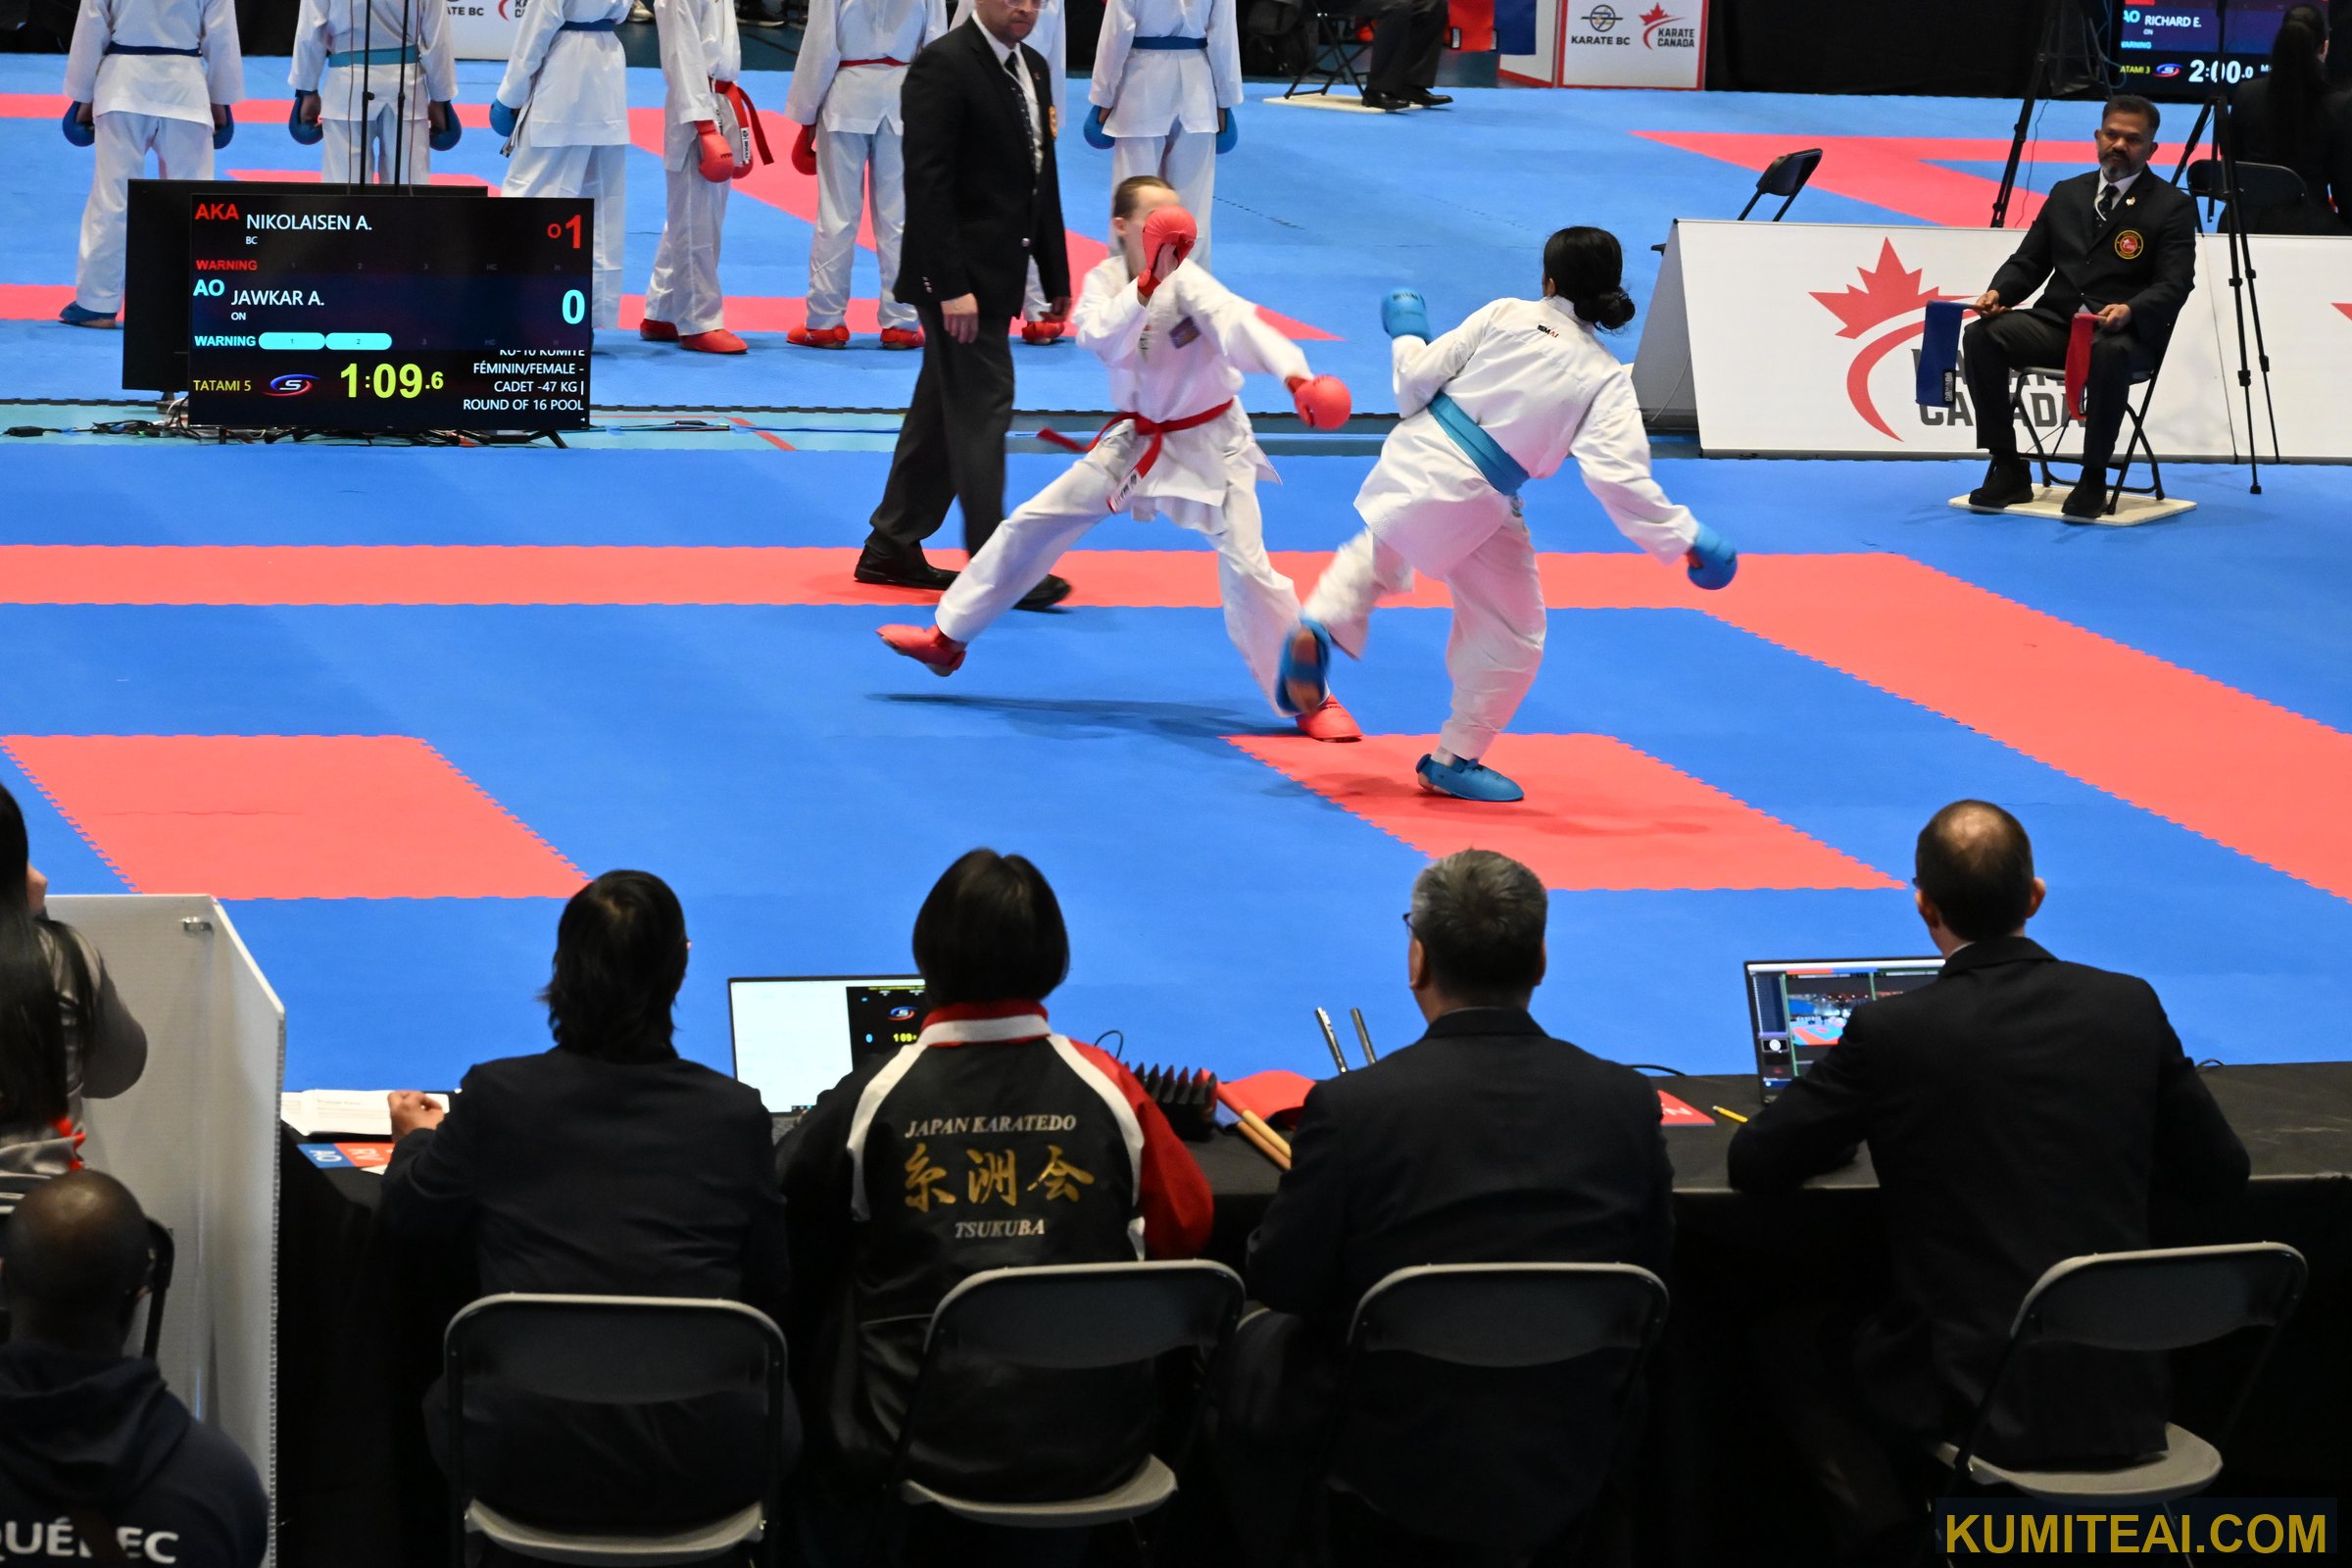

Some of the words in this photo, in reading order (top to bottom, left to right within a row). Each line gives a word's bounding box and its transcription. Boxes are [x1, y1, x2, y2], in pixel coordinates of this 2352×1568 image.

[468, 7, 484, 16] BC
[2144, 15, 2191, 27] RICHARD
[2192, 17, 2202, 27] E.
[1657, 27, 1695, 38] KARATE
[1571, 35, 1613, 45] KARATE
[1615, 36, 1631, 45] BC
[1657, 38, 1695, 47] CANADA
[195, 203, 240, 220] AKA
[246, 214, 351, 230] NIKOLAISEN
[355, 215, 372, 230] A.
[564, 215, 582, 249] 1
[245, 236, 258, 245] BC
[196, 260, 258, 270] WARNING
[193, 279, 225, 296] AO
[230, 290, 304, 306] JAWKAR
[308, 290, 325, 306] A.
[562, 290, 586, 324] 0
[230, 312, 246, 320] ON
[194, 335, 256, 347] WARNING
[473, 361, 575, 374] FÉMININ/FEMALE
[193, 380, 240, 391] TATAMI
[244, 380, 251, 391] 5
[494, 381, 533, 392] CADET
[538, 382, 557, 392] -47
[561, 381, 577, 392] KG
[463, 400, 509, 410] ROUND
[513, 400, 529, 410] OF
[534, 400, 547, 410] 16
[551, 400, 584, 411] POOL
[905, 1117, 969, 1138] JAPAN
[972, 1114, 1077, 1133] KARATEDO
[955, 1219, 1046, 1238] TSUKUBA
[0, 1517, 179, 1564] UÉEC
